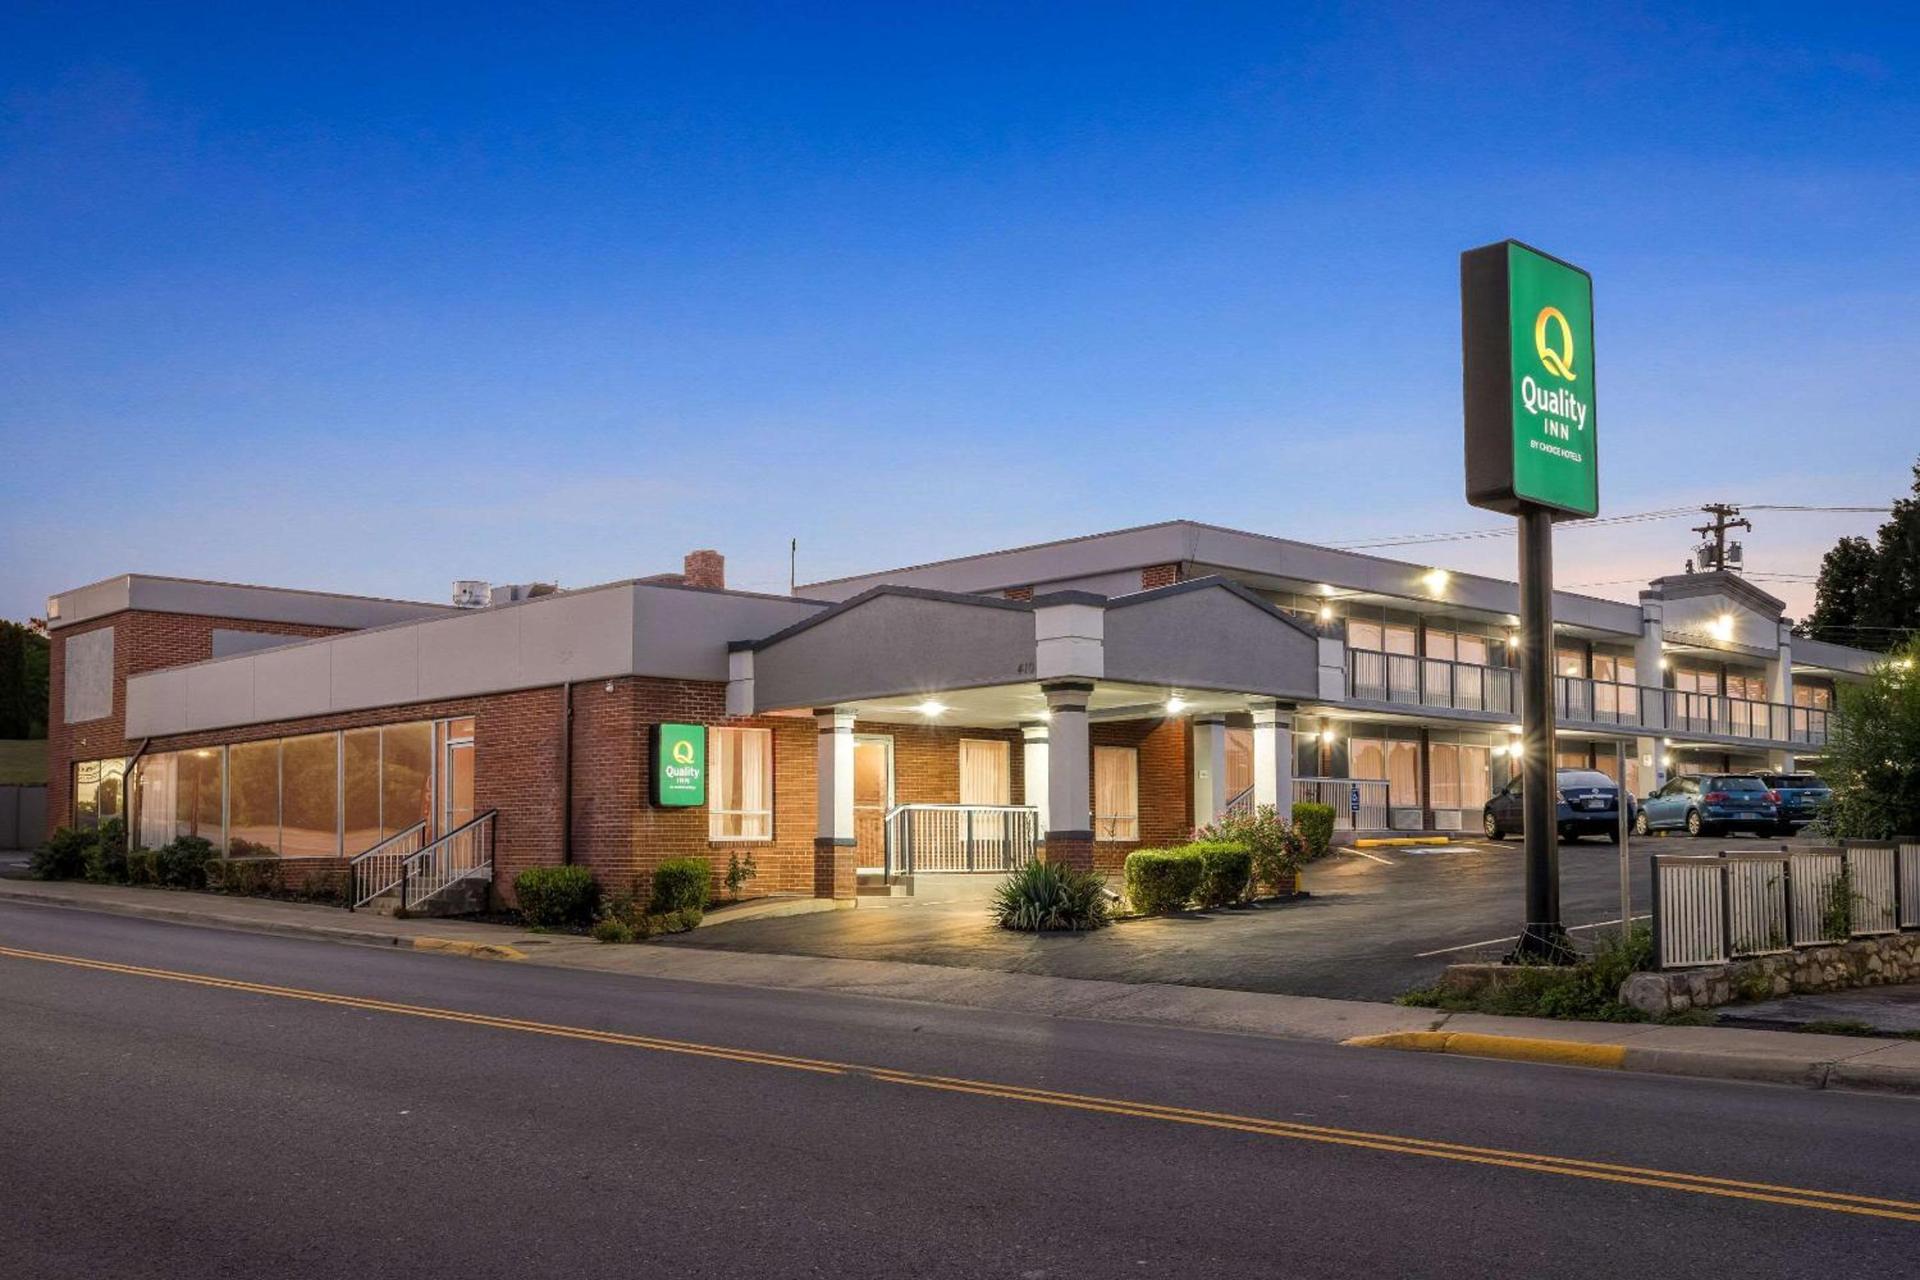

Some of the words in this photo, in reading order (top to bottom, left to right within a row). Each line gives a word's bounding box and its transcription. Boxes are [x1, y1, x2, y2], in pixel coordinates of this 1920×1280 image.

[1535, 307, 1576, 381] Q
[1521, 376, 1587, 430] Quality
[1544, 418, 1569, 440] INN
[1530, 439, 1539, 448] BY
[1540, 442, 1560, 457] CHOICE
[1561, 449, 1582, 462] HOTELS
[673, 741, 695, 764] Q
[665, 766, 700, 779] Quality
